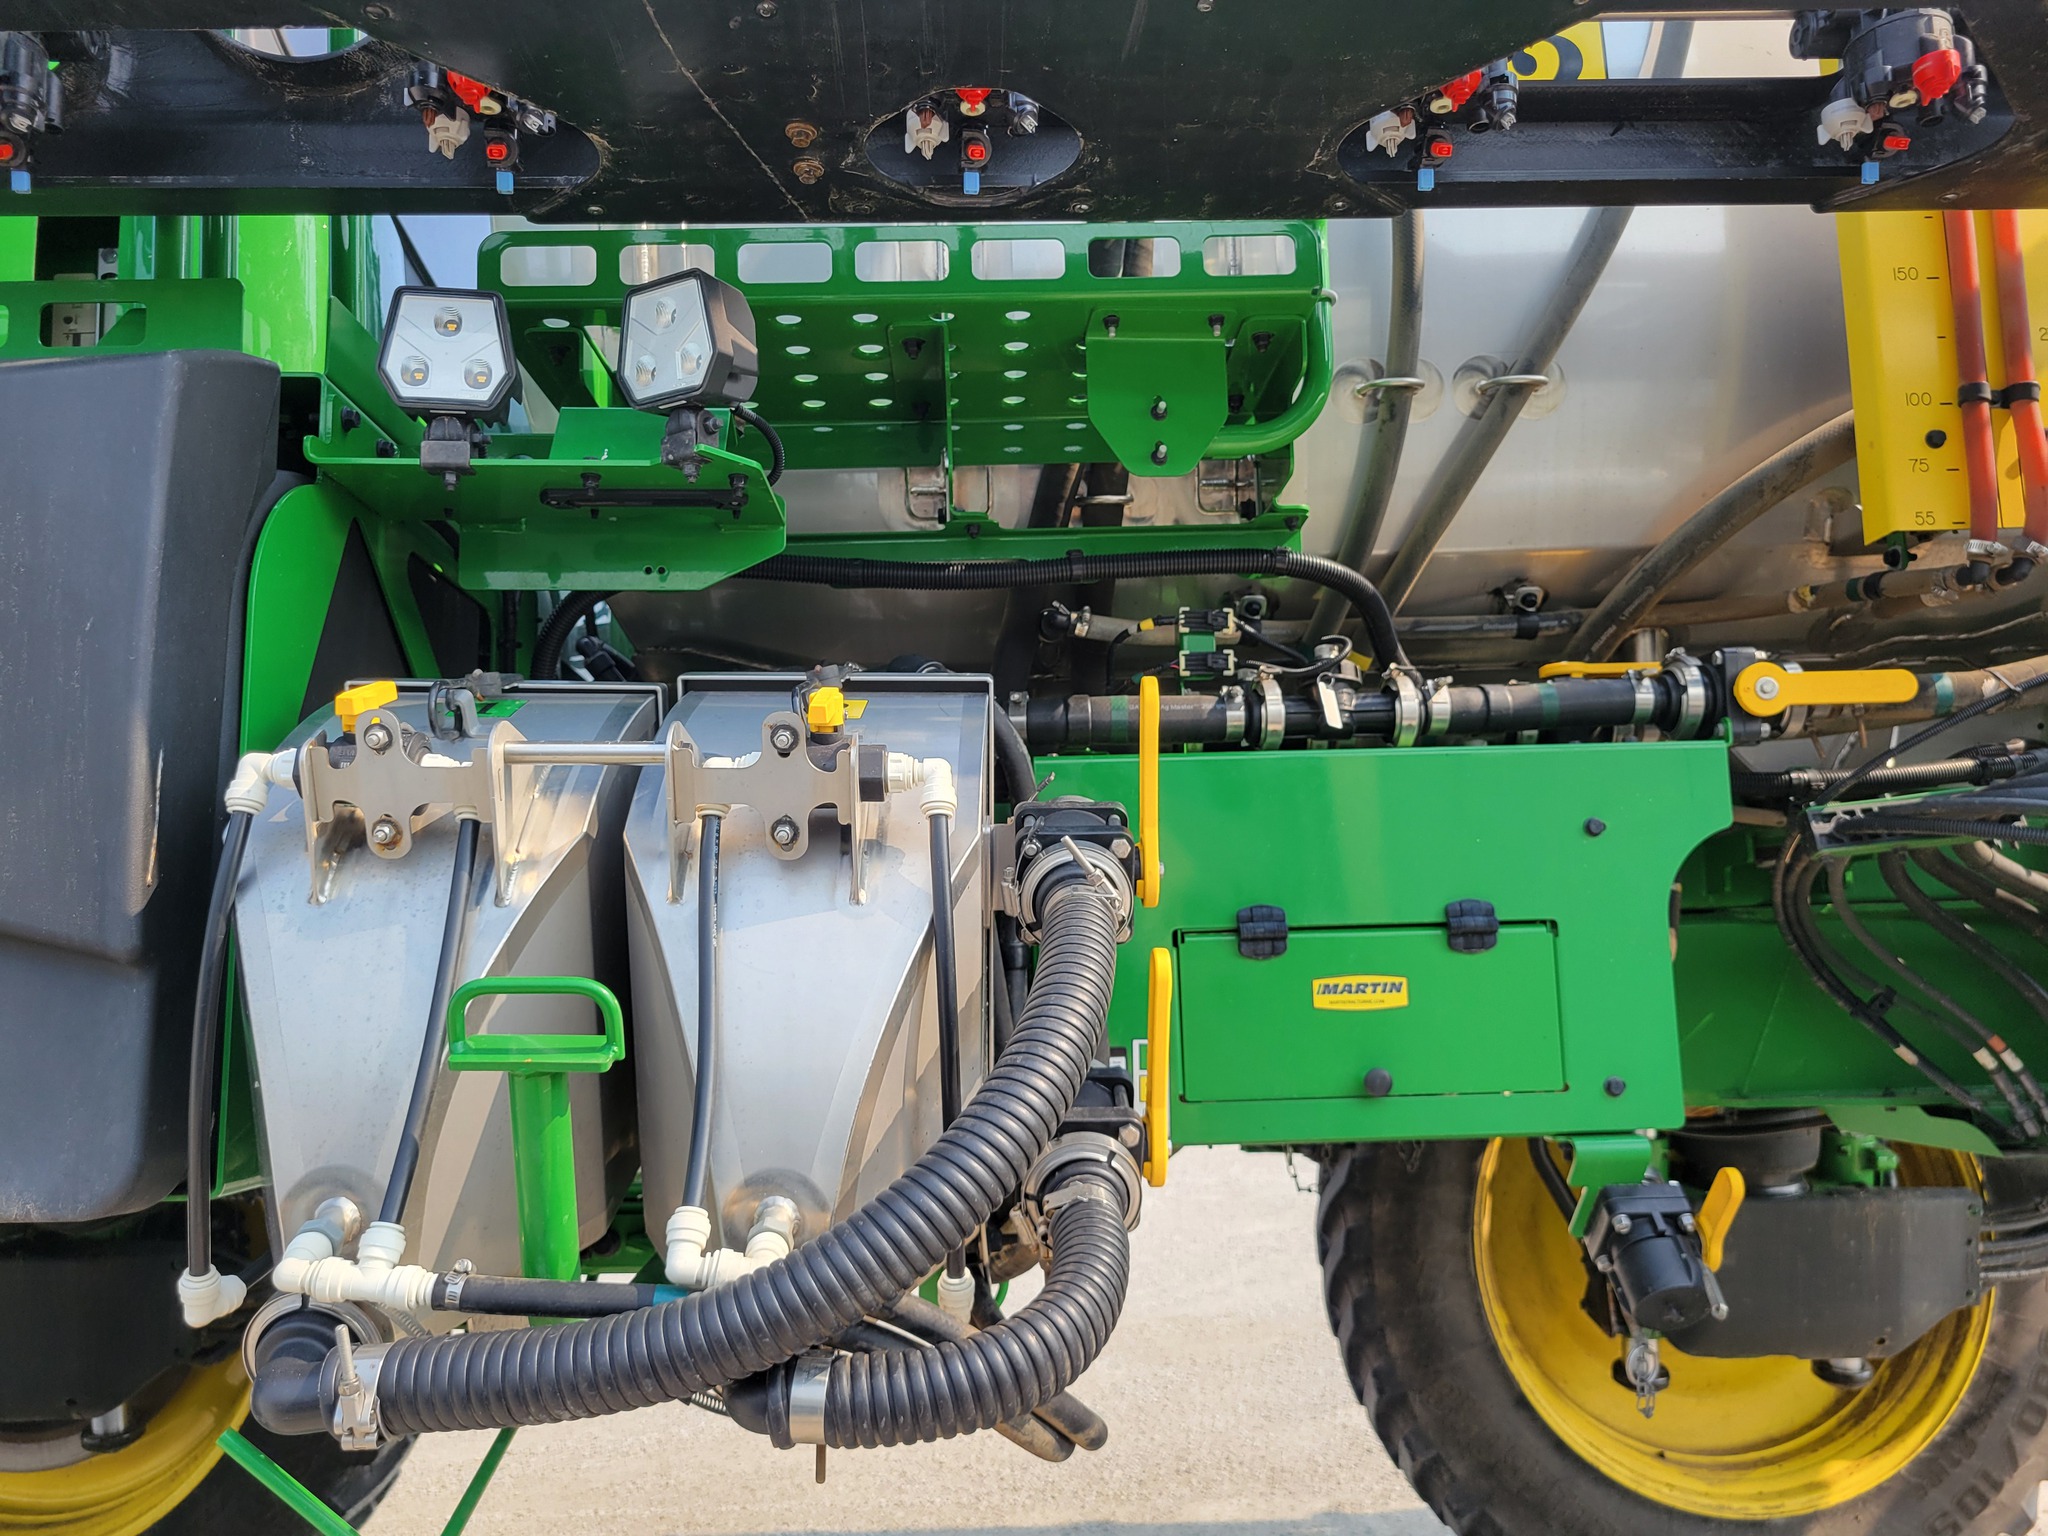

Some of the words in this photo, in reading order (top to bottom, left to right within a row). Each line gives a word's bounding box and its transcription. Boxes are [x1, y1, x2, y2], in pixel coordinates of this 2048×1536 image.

[1893, 266, 1919, 281] 150
[1905, 392, 1932, 406] 100
[1908, 458, 1930, 472] 75
[1914, 511, 1936, 526] 55
[1320, 982, 1403, 994] MARTIN
